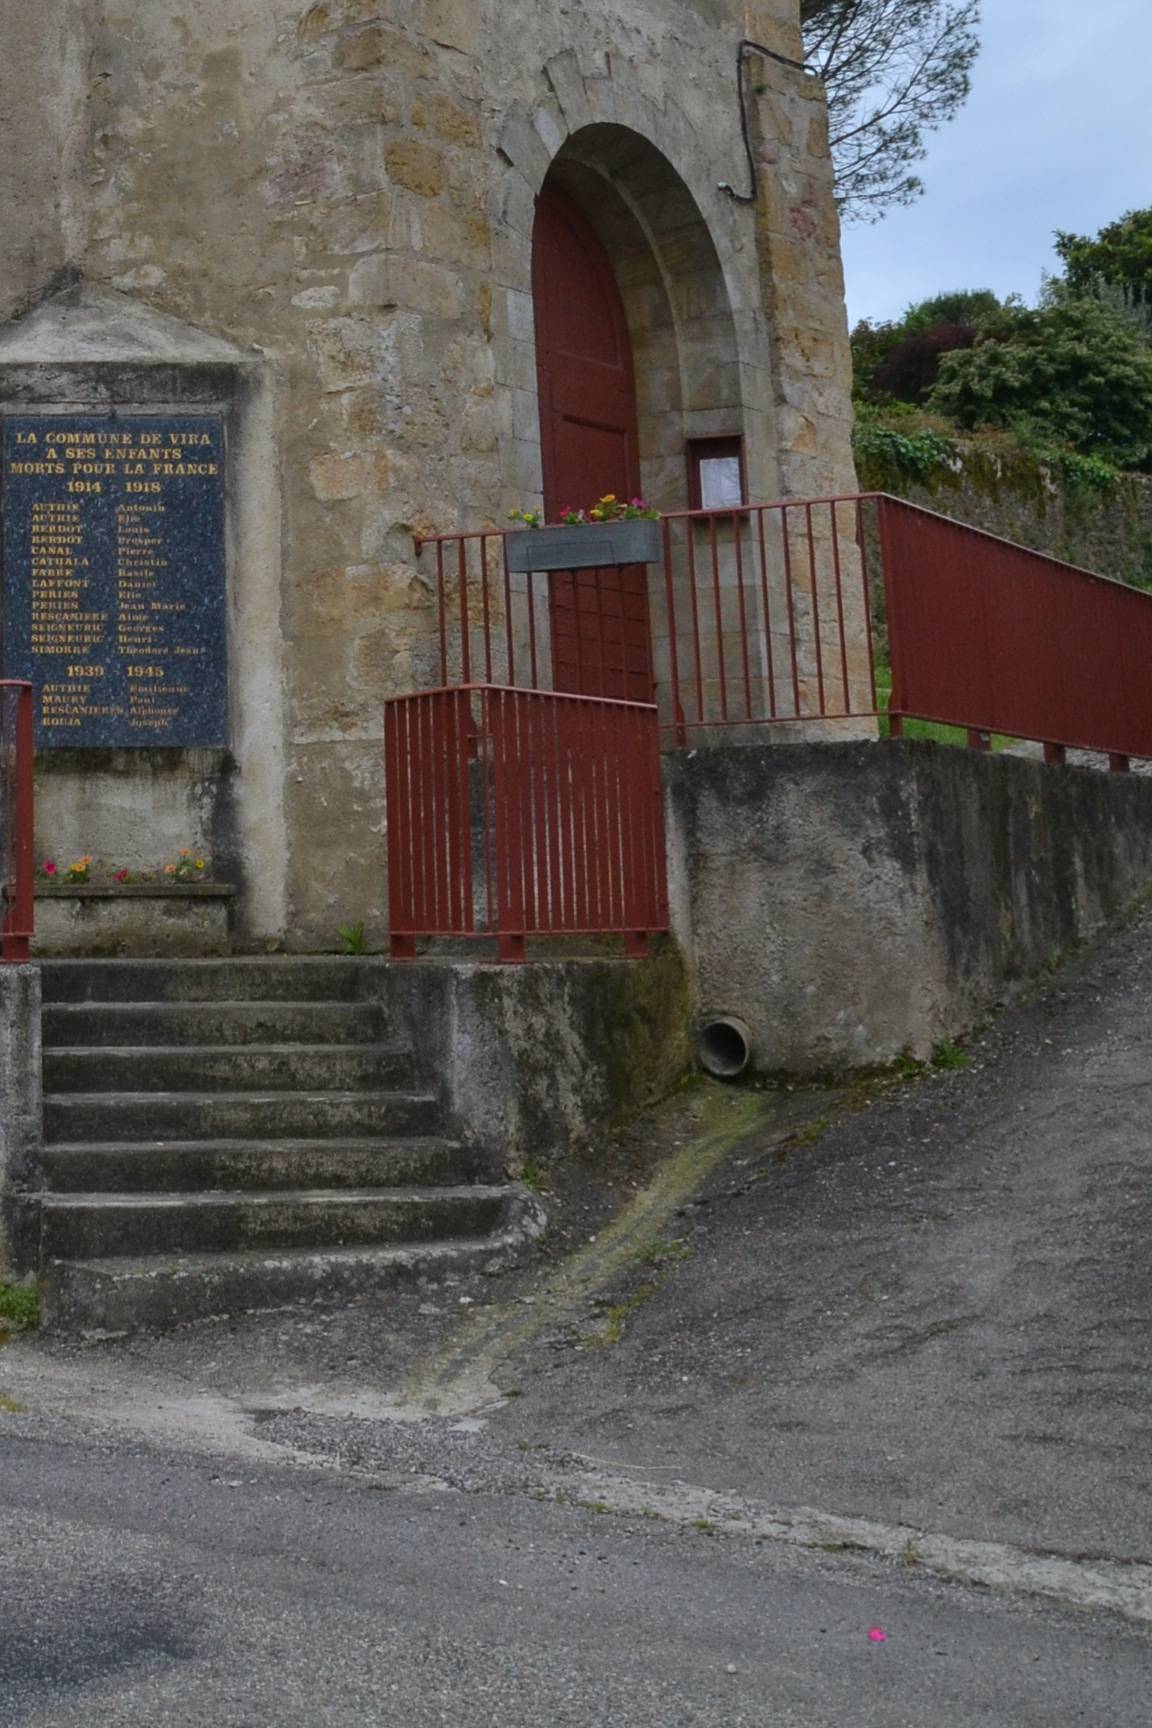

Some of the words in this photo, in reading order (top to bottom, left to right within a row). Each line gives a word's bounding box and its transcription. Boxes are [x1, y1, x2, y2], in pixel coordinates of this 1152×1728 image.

[16, 433, 37, 444] LA
[45, 433, 132, 445] COMMUNE
[140, 434, 161, 445] DE
[170, 434, 211, 445] VIRA
[47, 448, 57, 459] A
[65, 449, 96, 459] SES
[104, 449, 182, 460] ENFANTS
[10, 463, 65, 474] MORTS
[73, 464, 116, 475] POUR
[125, 464, 144, 474] LA
[154, 464, 218, 475] FRANCE
[67, 482, 101, 493] 1914
[125, 482, 161, 493] 1918
[32, 547, 72, 556] CANAL
[67, 665, 104, 677] 1939
[127, 666, 164, 677] 1945
